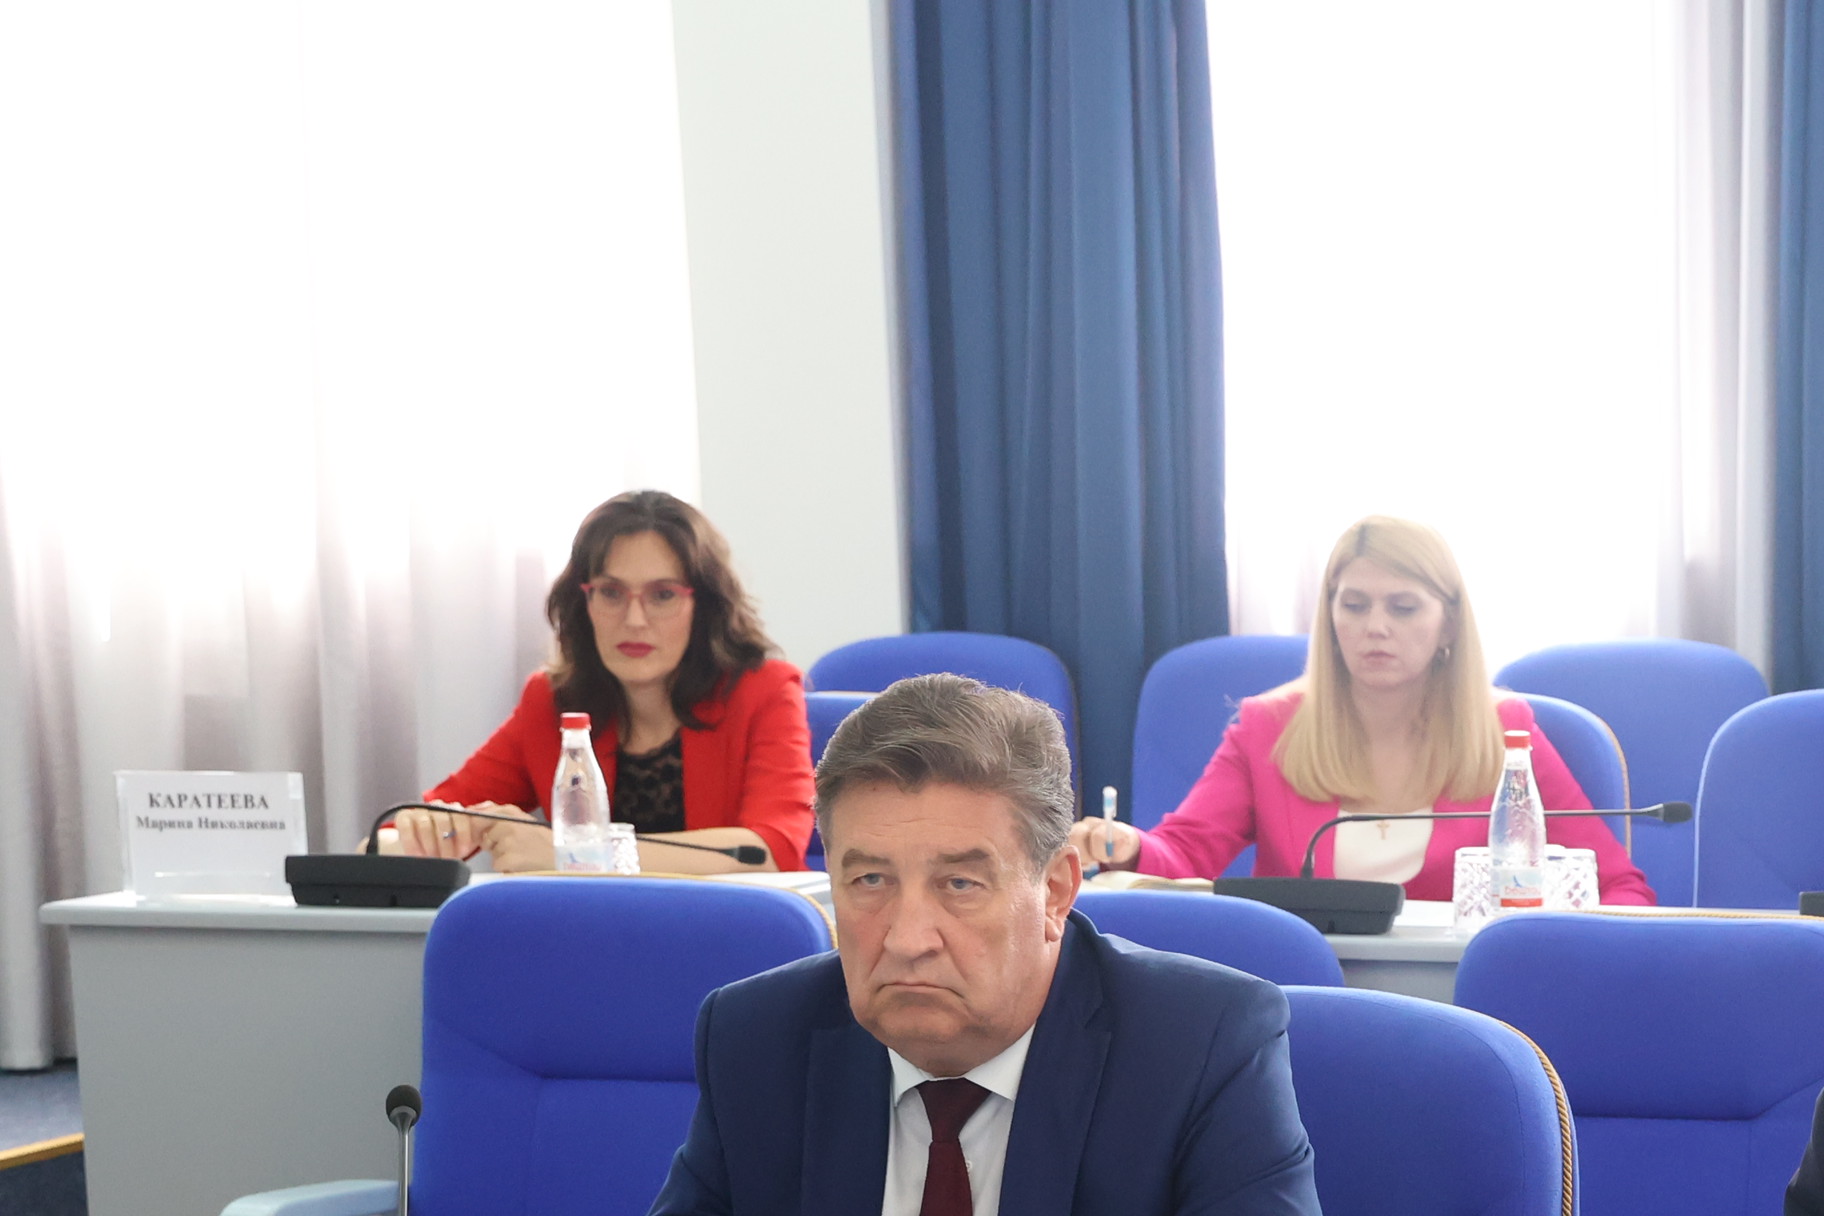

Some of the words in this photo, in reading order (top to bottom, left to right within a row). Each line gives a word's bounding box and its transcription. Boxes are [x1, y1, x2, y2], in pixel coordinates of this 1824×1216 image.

[148, 792, 270, 810] КАРАТЕЕВА
[136, 815, 194, 833] Марина
[197, 816, 287, 831] Николаевна
